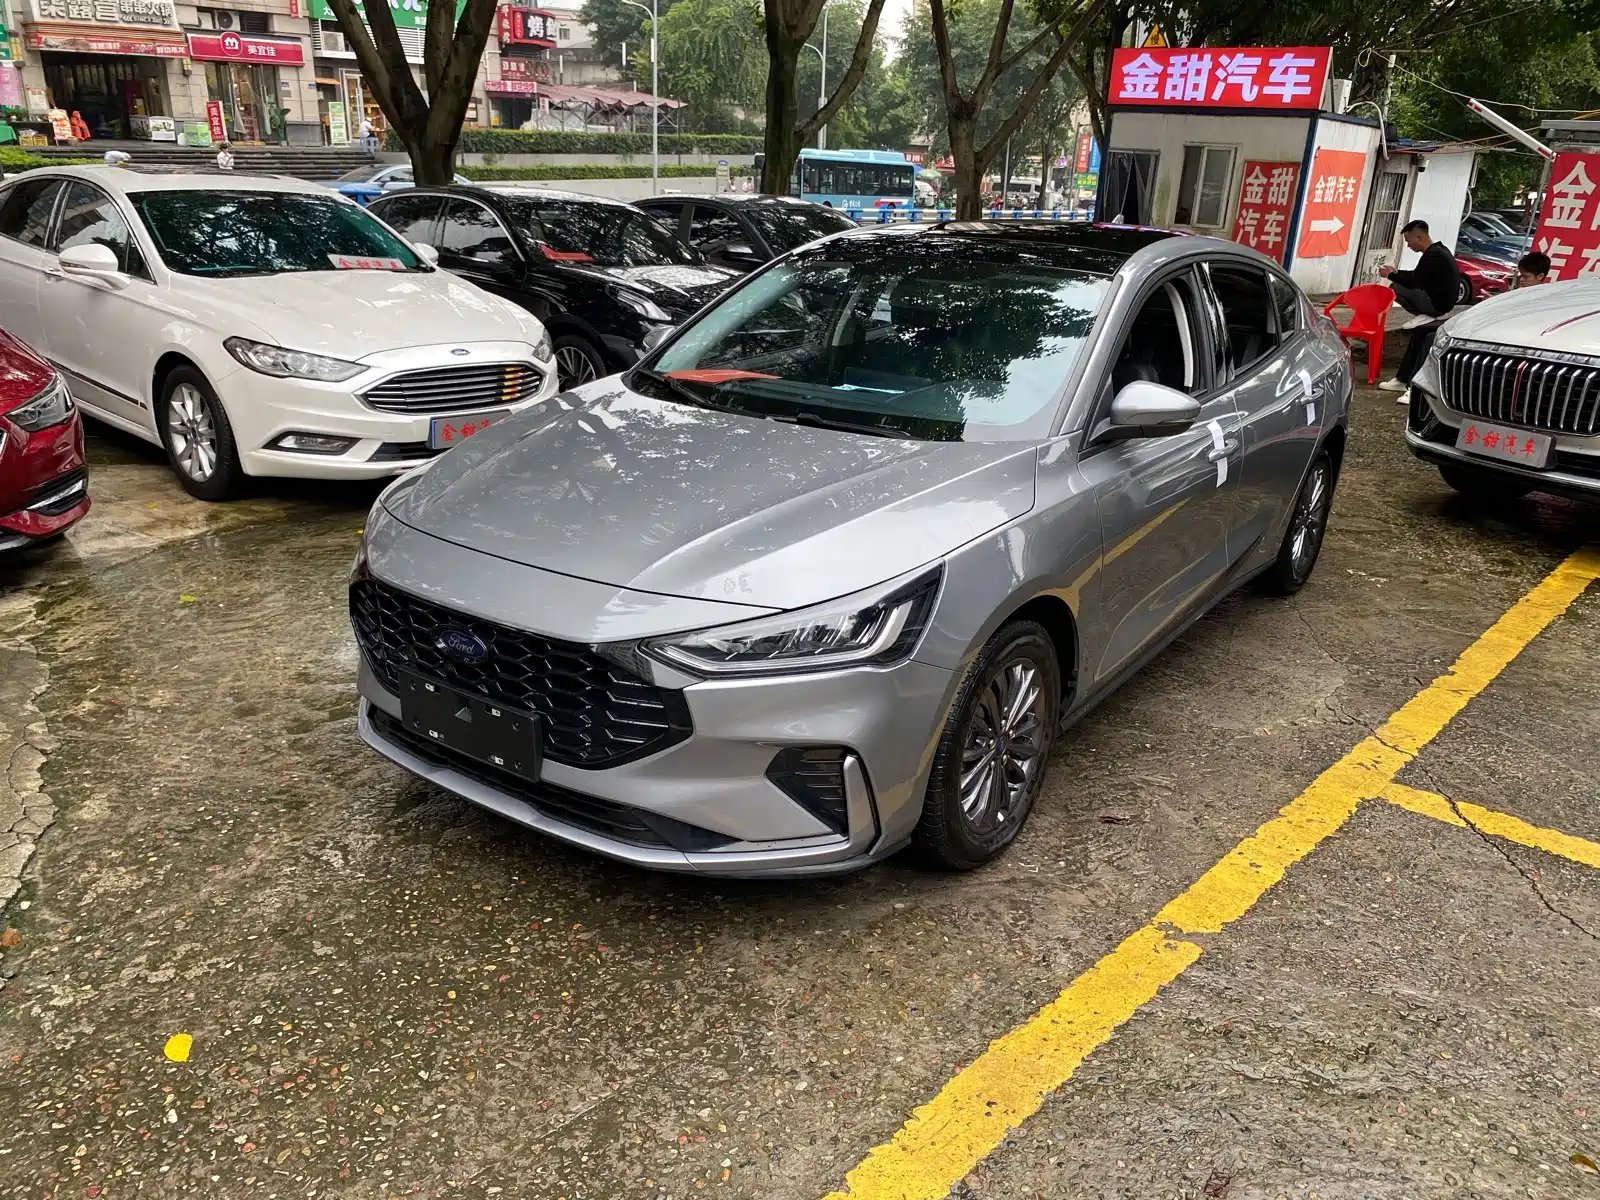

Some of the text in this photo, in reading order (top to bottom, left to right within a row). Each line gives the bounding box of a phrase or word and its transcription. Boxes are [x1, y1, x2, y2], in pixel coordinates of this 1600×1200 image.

[247, 44, 277, 57] 美宜佳
[1119, 53, 1316, 103] 金甜汽车
[1243, 165, 1295, 206] 金甜
[1313, 175, 1356, 205] 金甜汽车
[1543, 160, 1600, 231] 金
[1236, 208, 1285, 249] 汽车
[1463, 424, 1536, 459] 金甜汽车
[448, 633, 476, 655] Ford
